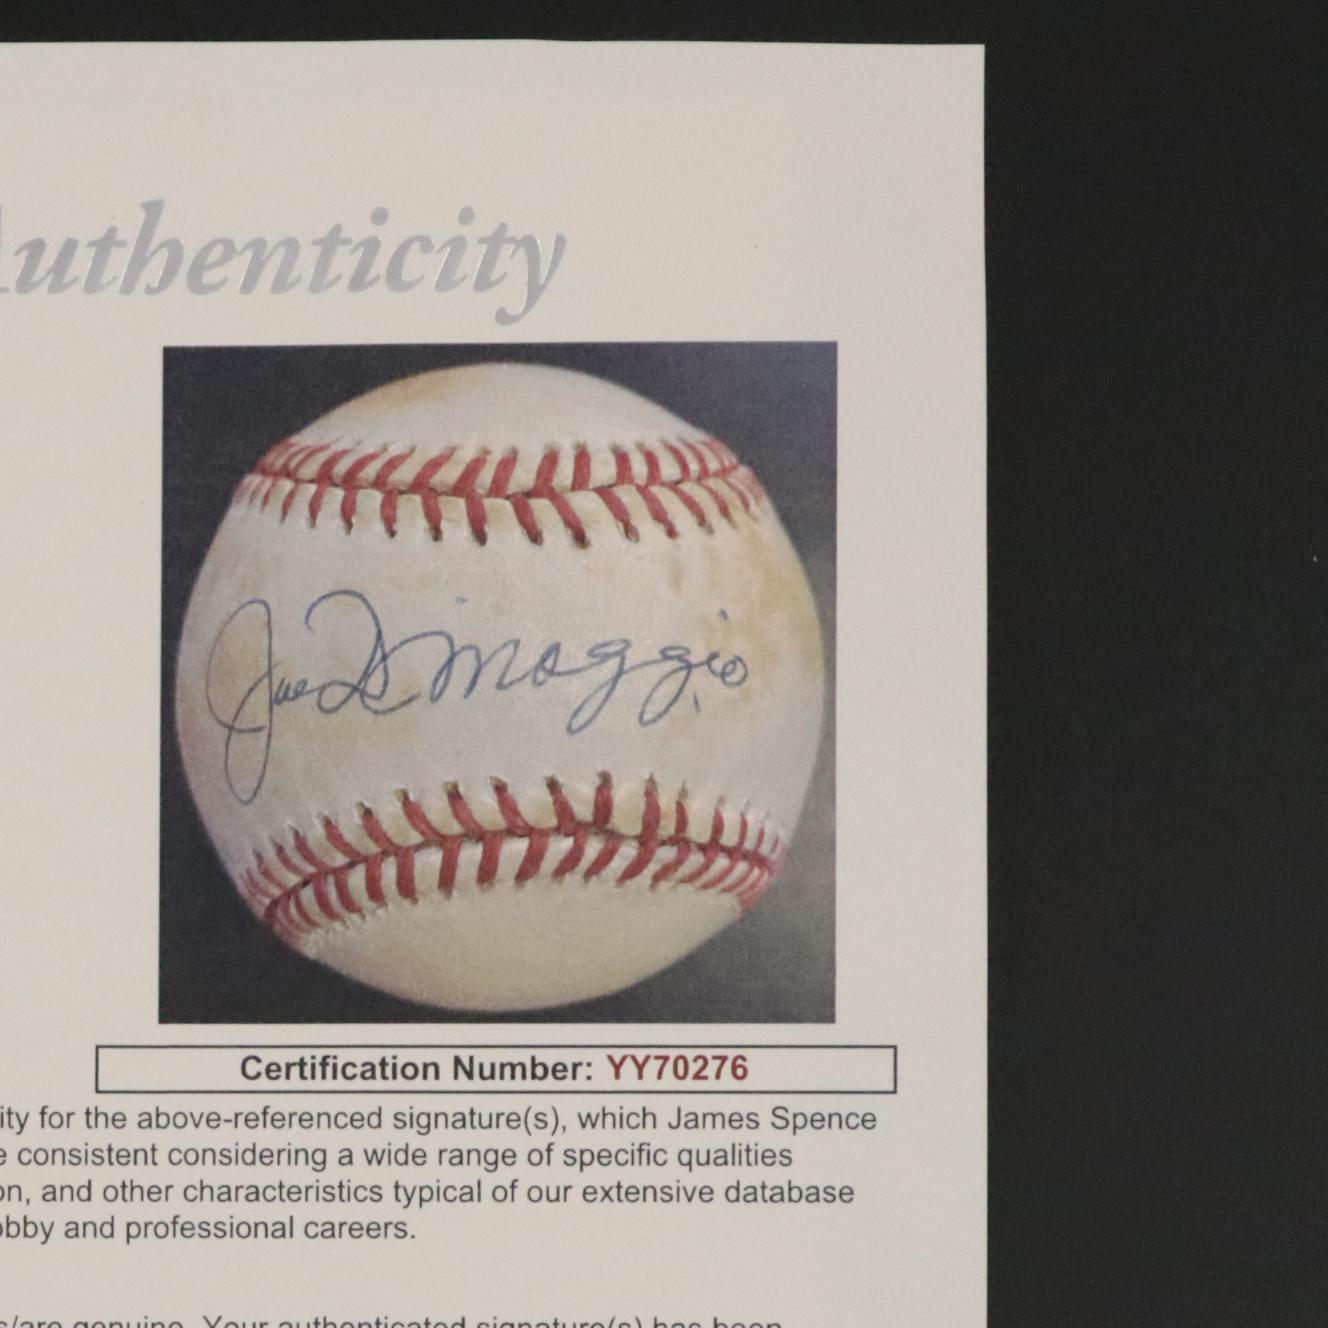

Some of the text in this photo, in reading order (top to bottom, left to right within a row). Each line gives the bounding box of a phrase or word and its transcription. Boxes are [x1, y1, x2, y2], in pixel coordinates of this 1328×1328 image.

[241, 1055, 748, 1081] Certification Number: YY70276
[64, 1215, 114, 1239] and
[126, 1214, 294, 1245] professional
[304, 1221, 415, 1239] careers.
